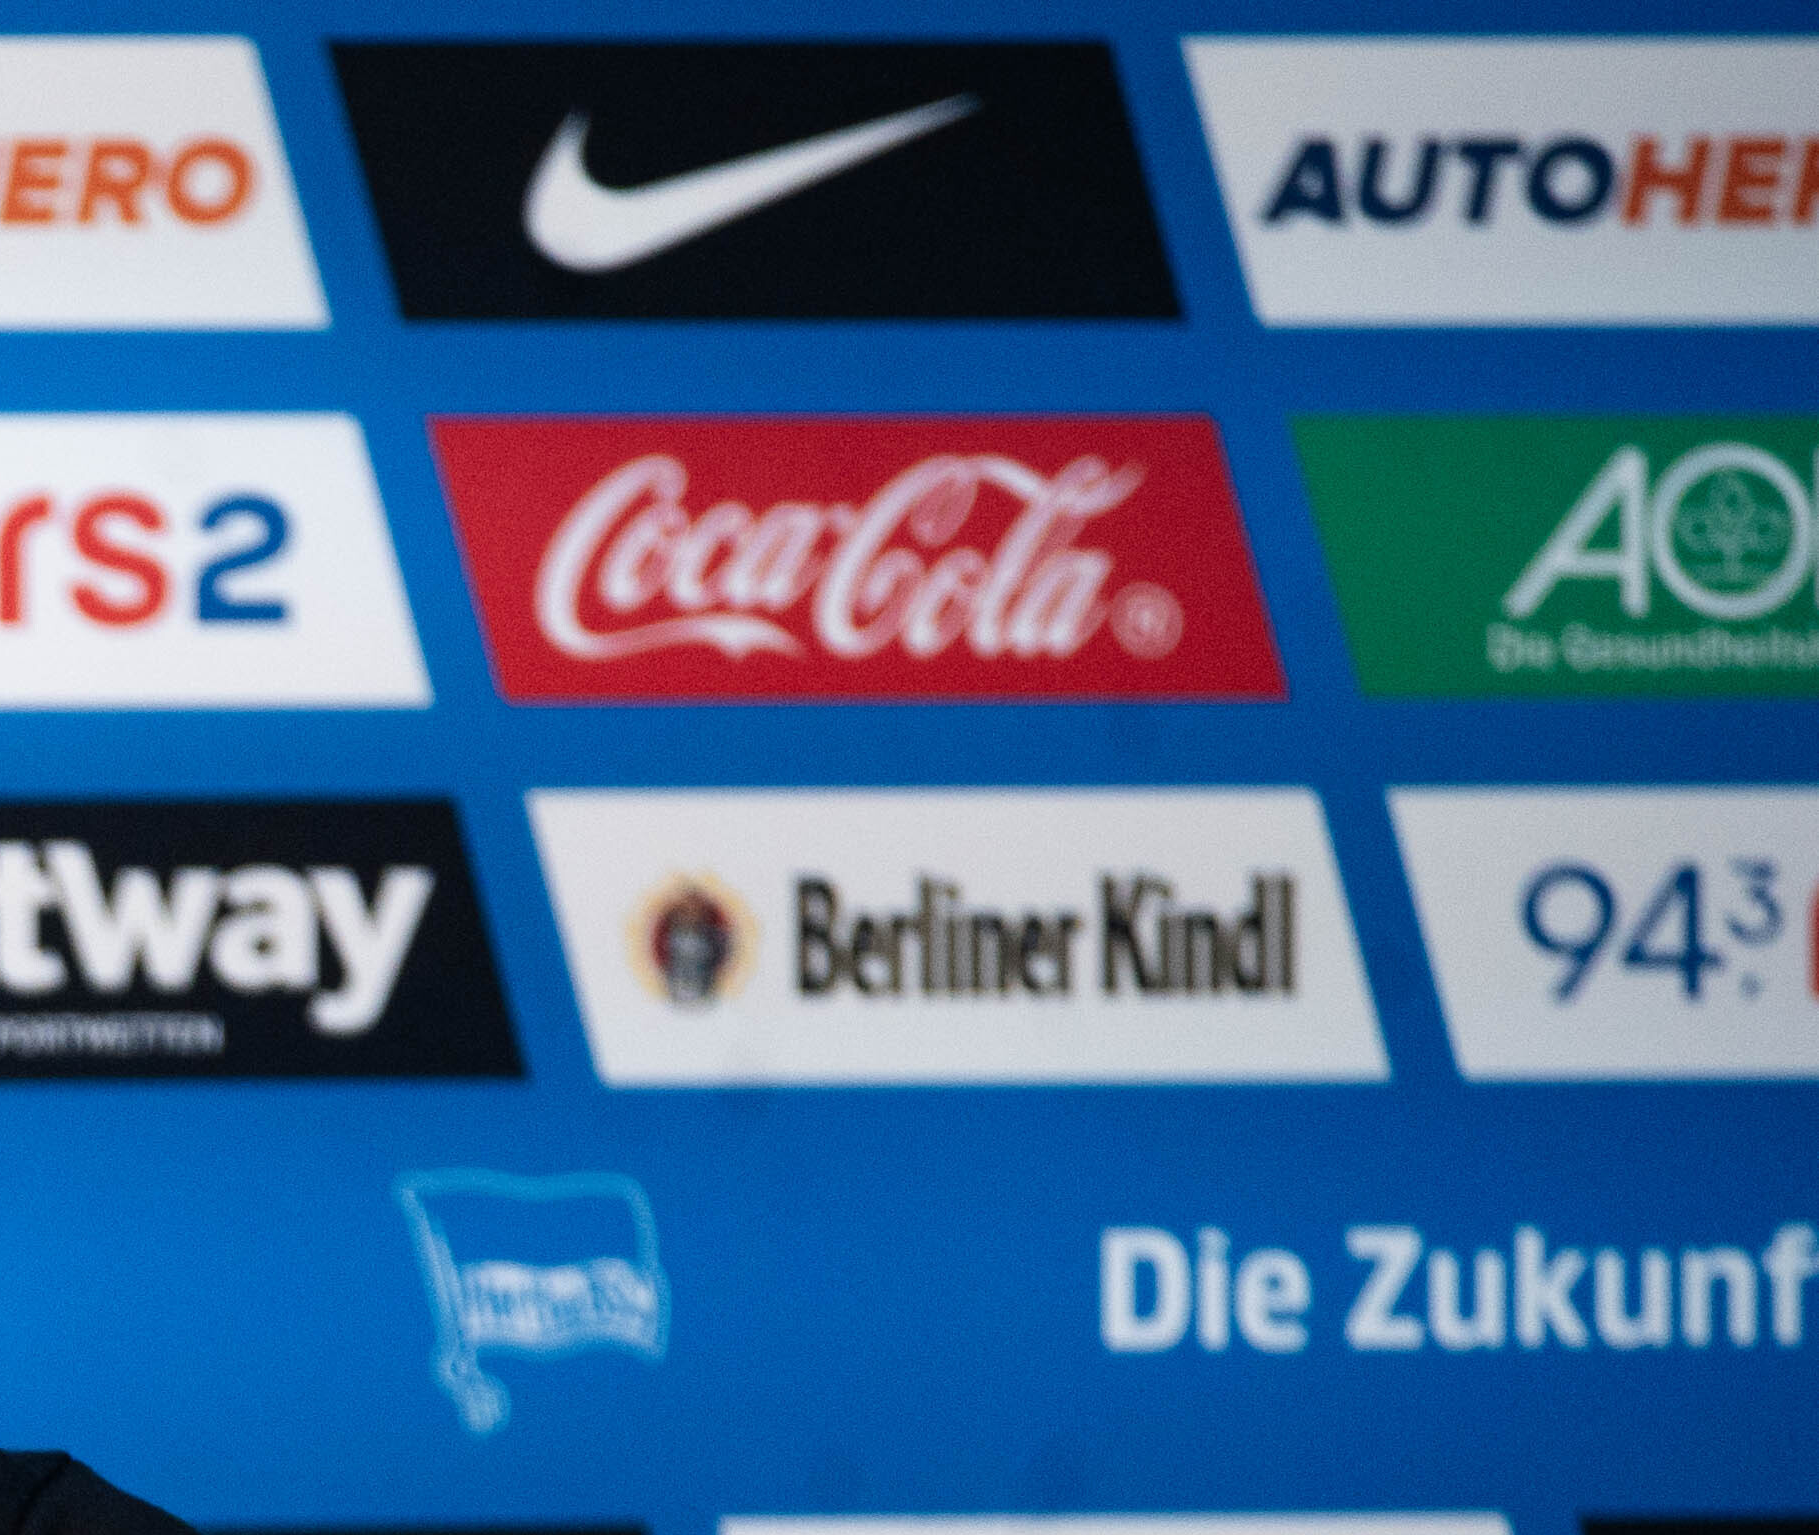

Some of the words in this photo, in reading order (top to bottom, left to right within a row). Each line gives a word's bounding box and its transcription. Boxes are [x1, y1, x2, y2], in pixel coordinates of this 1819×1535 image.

[534, 455, 1148, 660] Coca-Cola
[1503, 443, 1819, 620] AO
[793, 875, 1083, 999] Berliner
[1098, 874, 1297, 998] Kindl
[1101, 1228, 1310, 1351] Die
